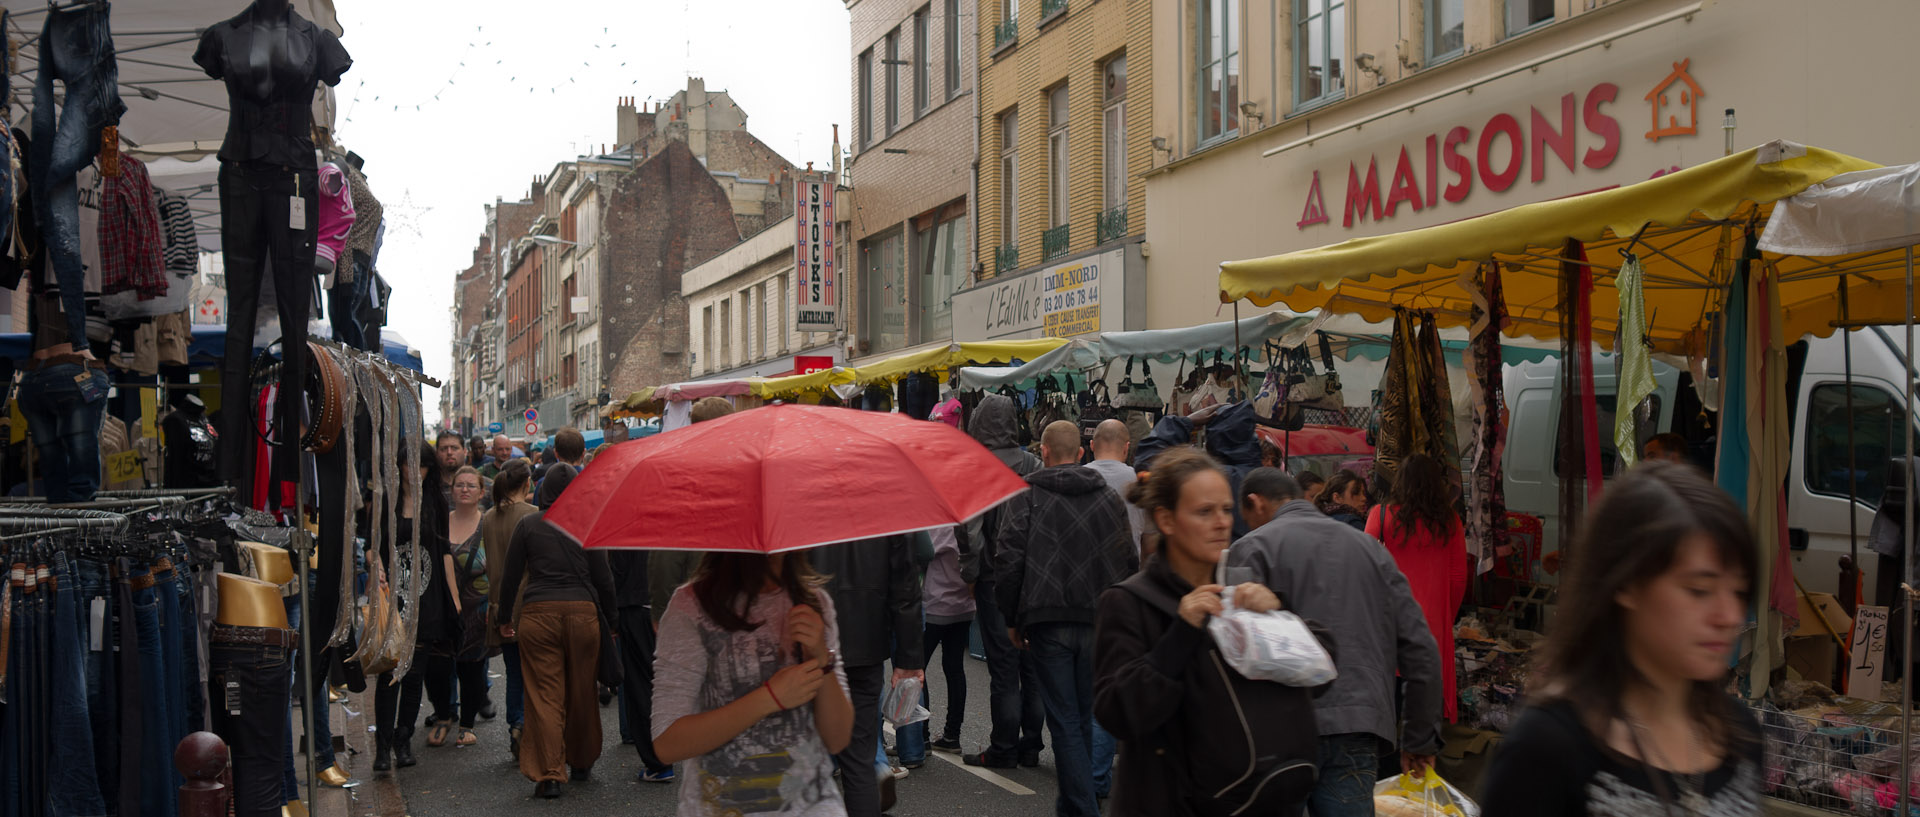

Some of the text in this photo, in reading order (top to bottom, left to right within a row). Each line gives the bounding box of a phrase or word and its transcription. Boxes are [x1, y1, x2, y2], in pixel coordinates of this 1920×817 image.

[1342, 82, 1621, 228] MAISONS
[811, 184, 820, 303] STOCKS
[1044, 265, 1098, 292] IMM-NORD
[1044, 285, 1098, 313] 03 20 06 78 44
[799, 311, 834, 325] AMERICAINS
[1058, 320, 1093, 336] COMMERCIAL
[1060, 309, 1074, 324] CAUSE
[1075, 305, 1099, 321] TRANSFERT
